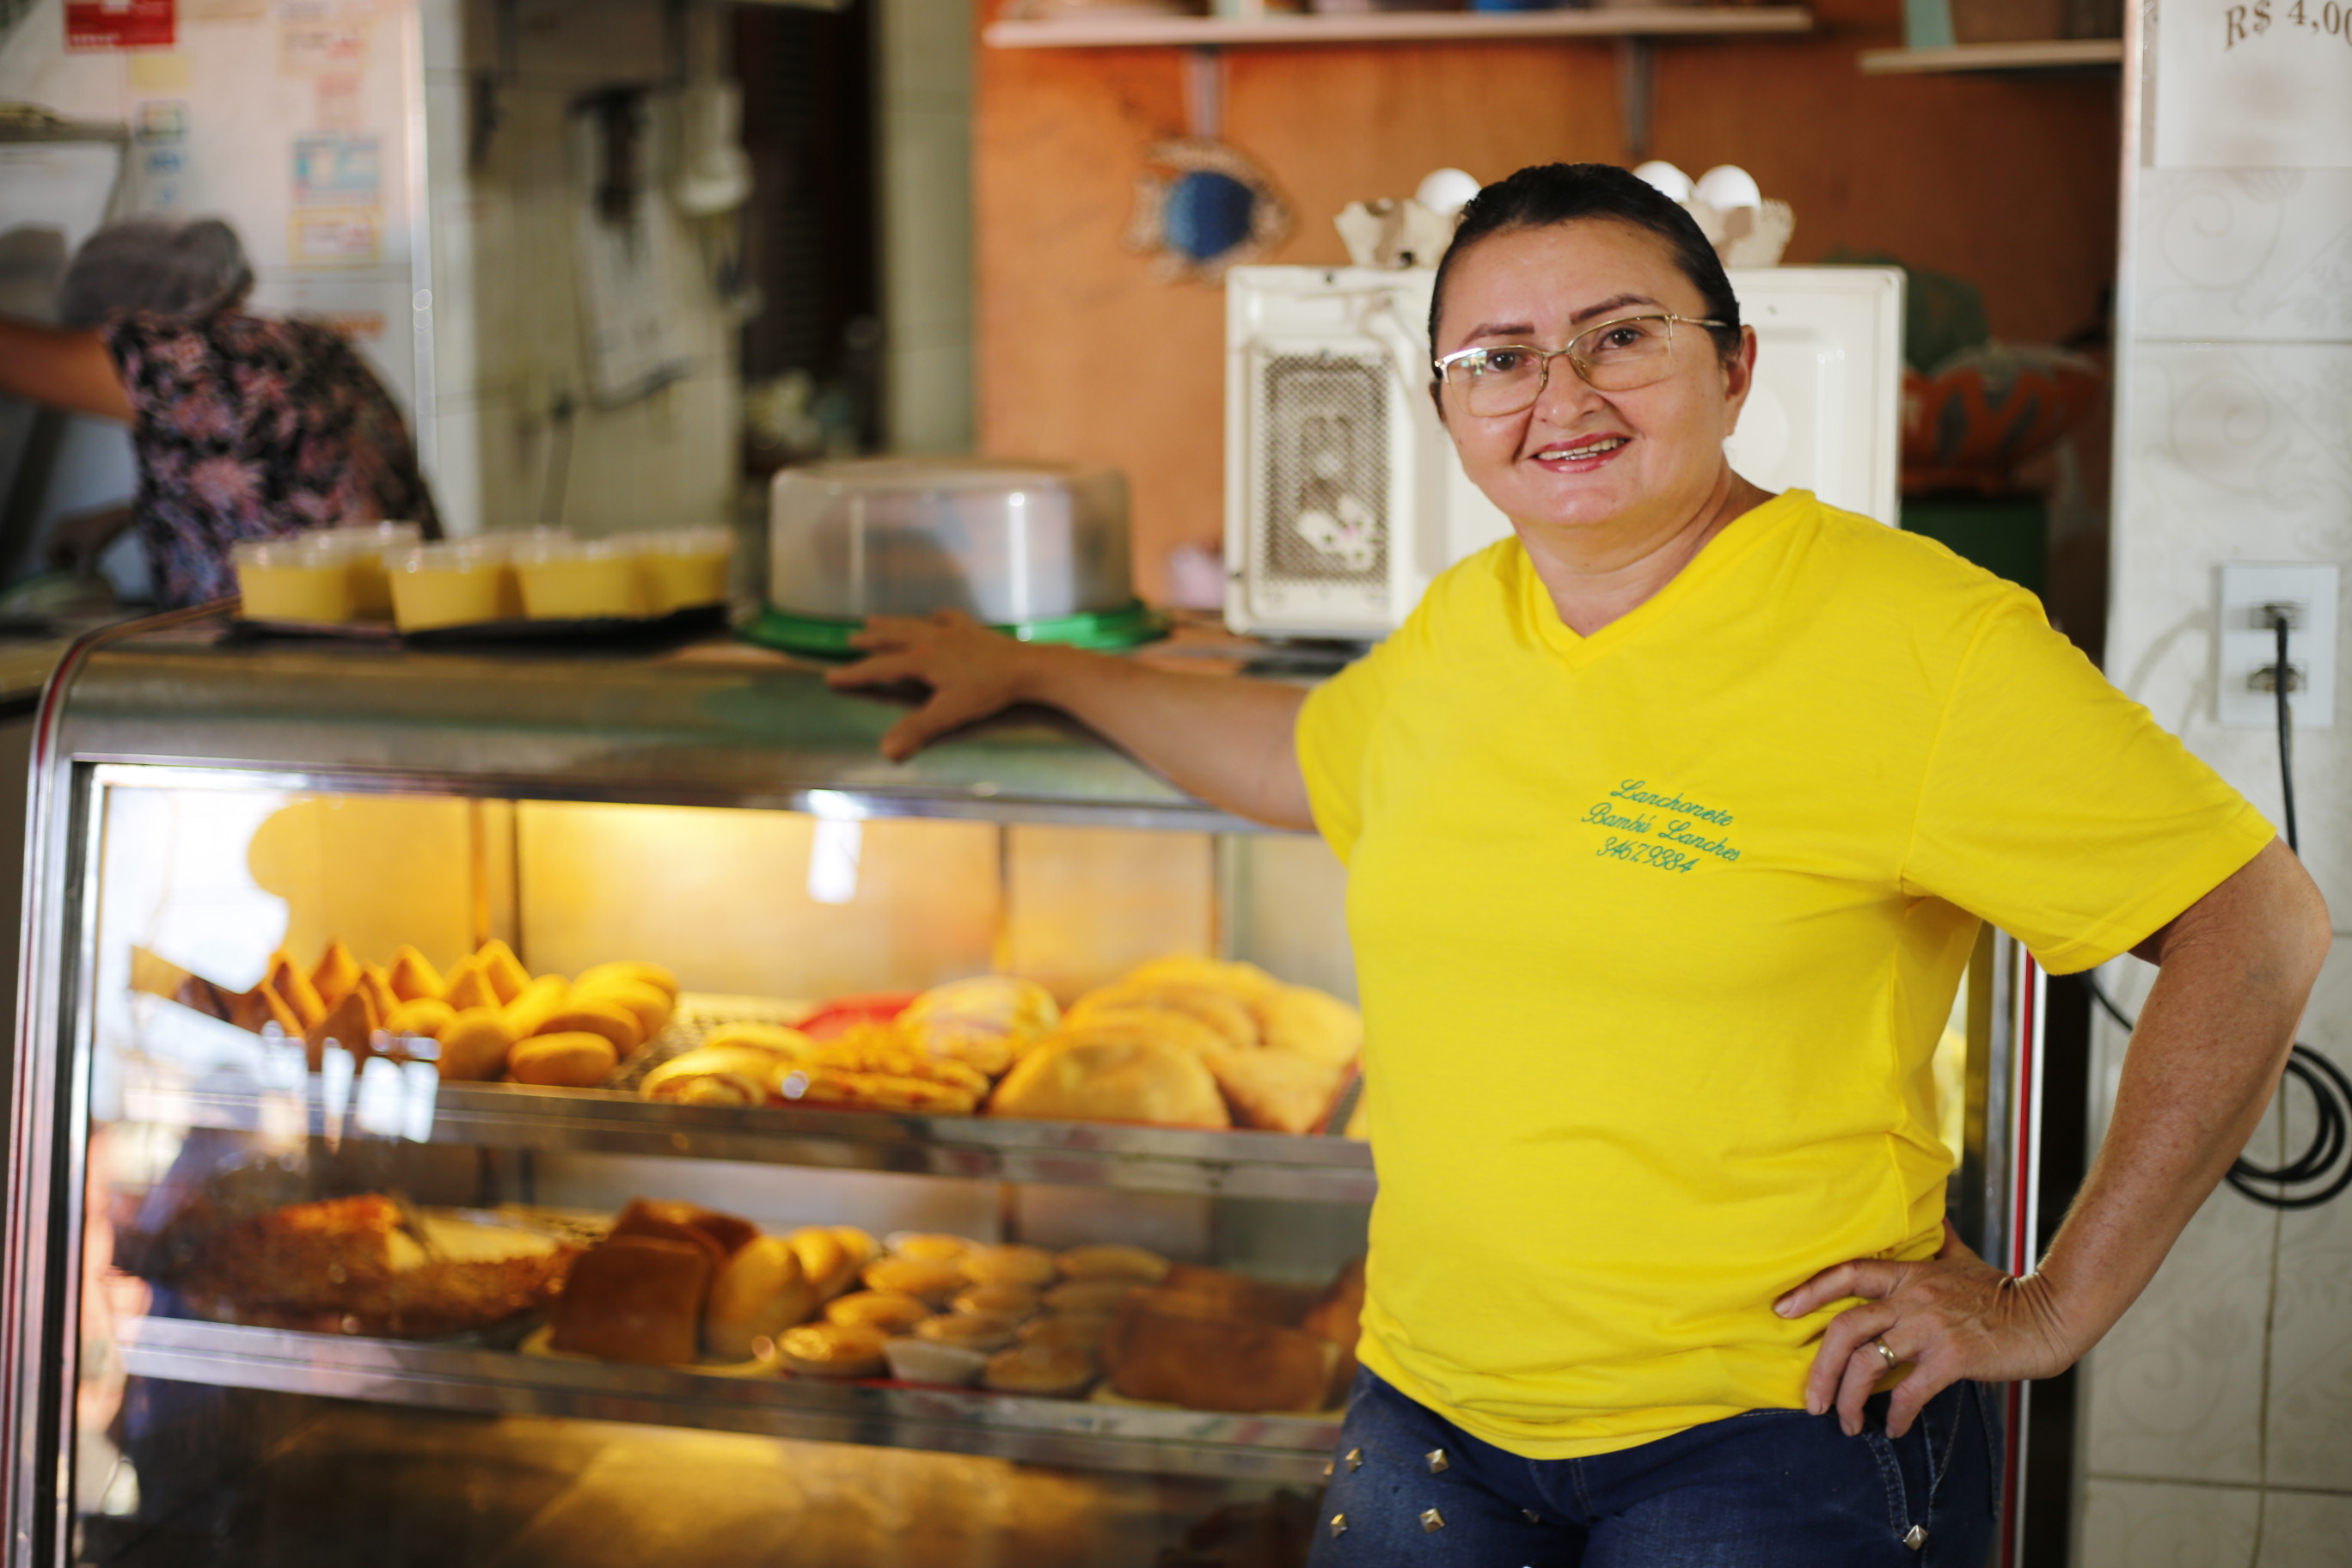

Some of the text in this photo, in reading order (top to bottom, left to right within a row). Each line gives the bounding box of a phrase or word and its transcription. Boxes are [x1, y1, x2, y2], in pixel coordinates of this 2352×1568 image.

[2224, 0, 2272, 50] R$
[1609, 778, 1734, 827] Lanchonete
[1657, 819, 1741, 861] Lanches
